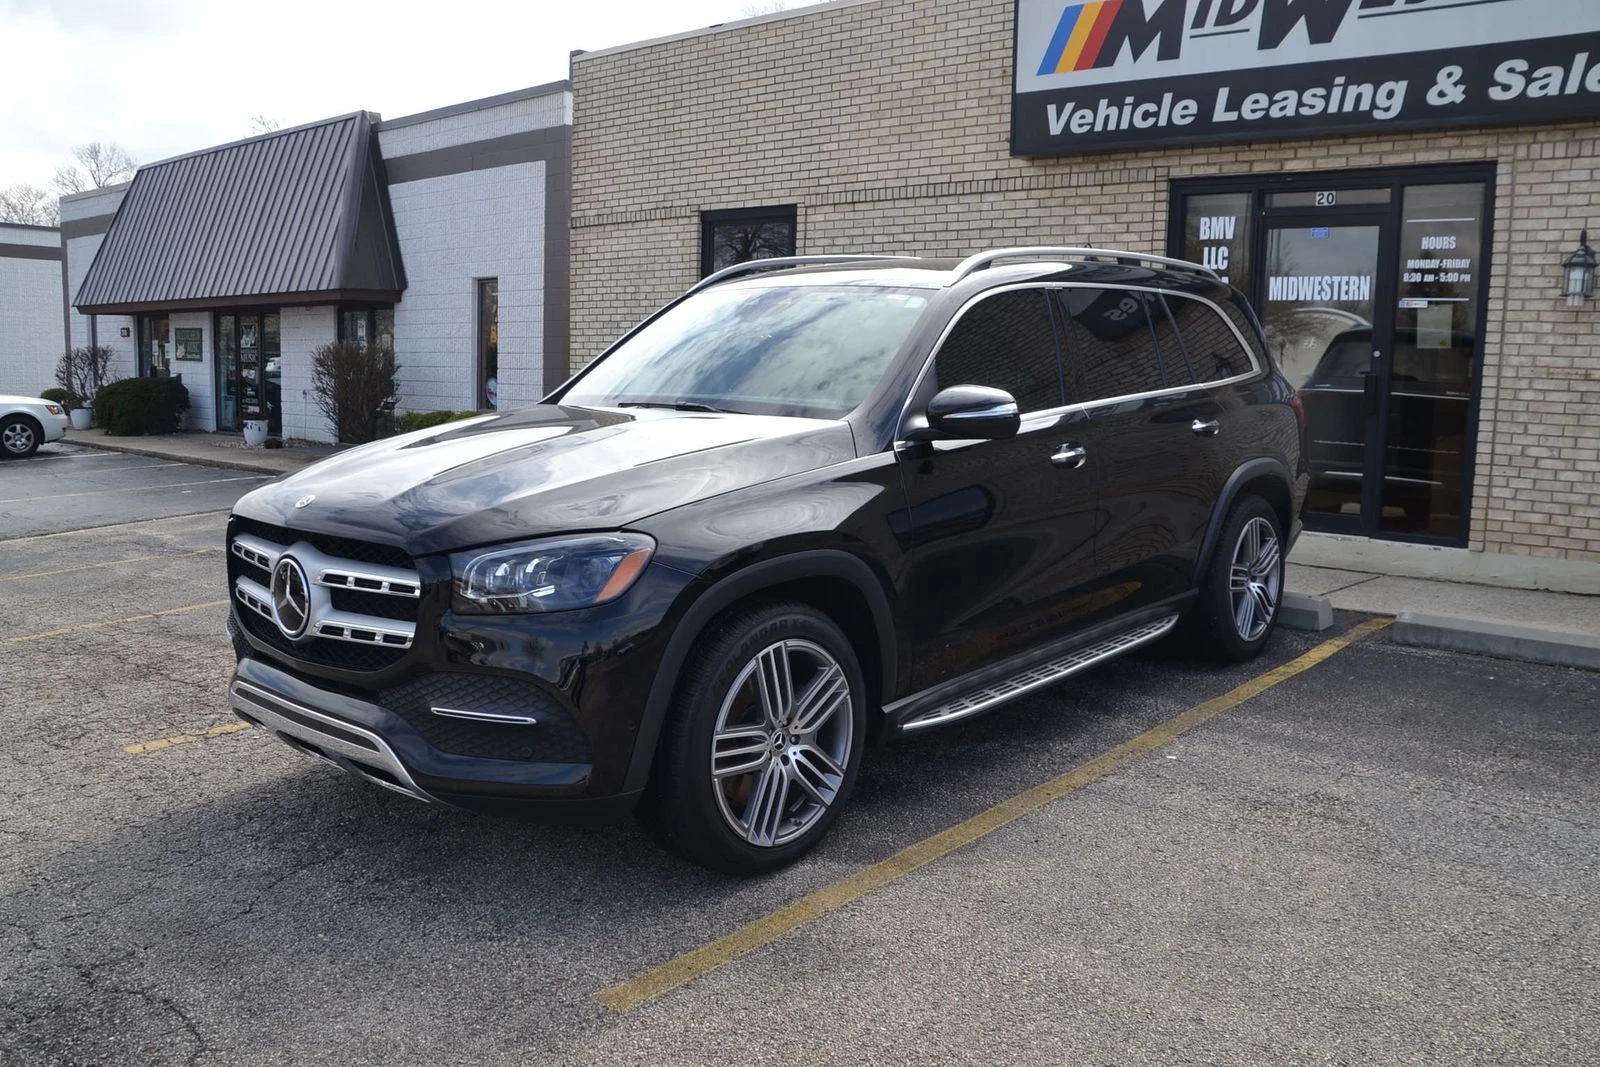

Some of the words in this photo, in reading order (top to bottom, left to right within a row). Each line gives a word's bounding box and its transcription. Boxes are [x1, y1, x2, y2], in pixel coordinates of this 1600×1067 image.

[1046, 92, 1197, 136] Vehicle
[1212, 77, 1407, 122] Leasing
[1426, 65, 1466, 105] &
[1317, 192, 1335, 205] 20
[1421, 236, 1457, 250] HOURS
[1203, 246, 1229, 270] LLC
[1407, 259, 1471, 269] MONDAY-FRIDAY
[1269, 276, 1370, 301] MIDWESTERN
